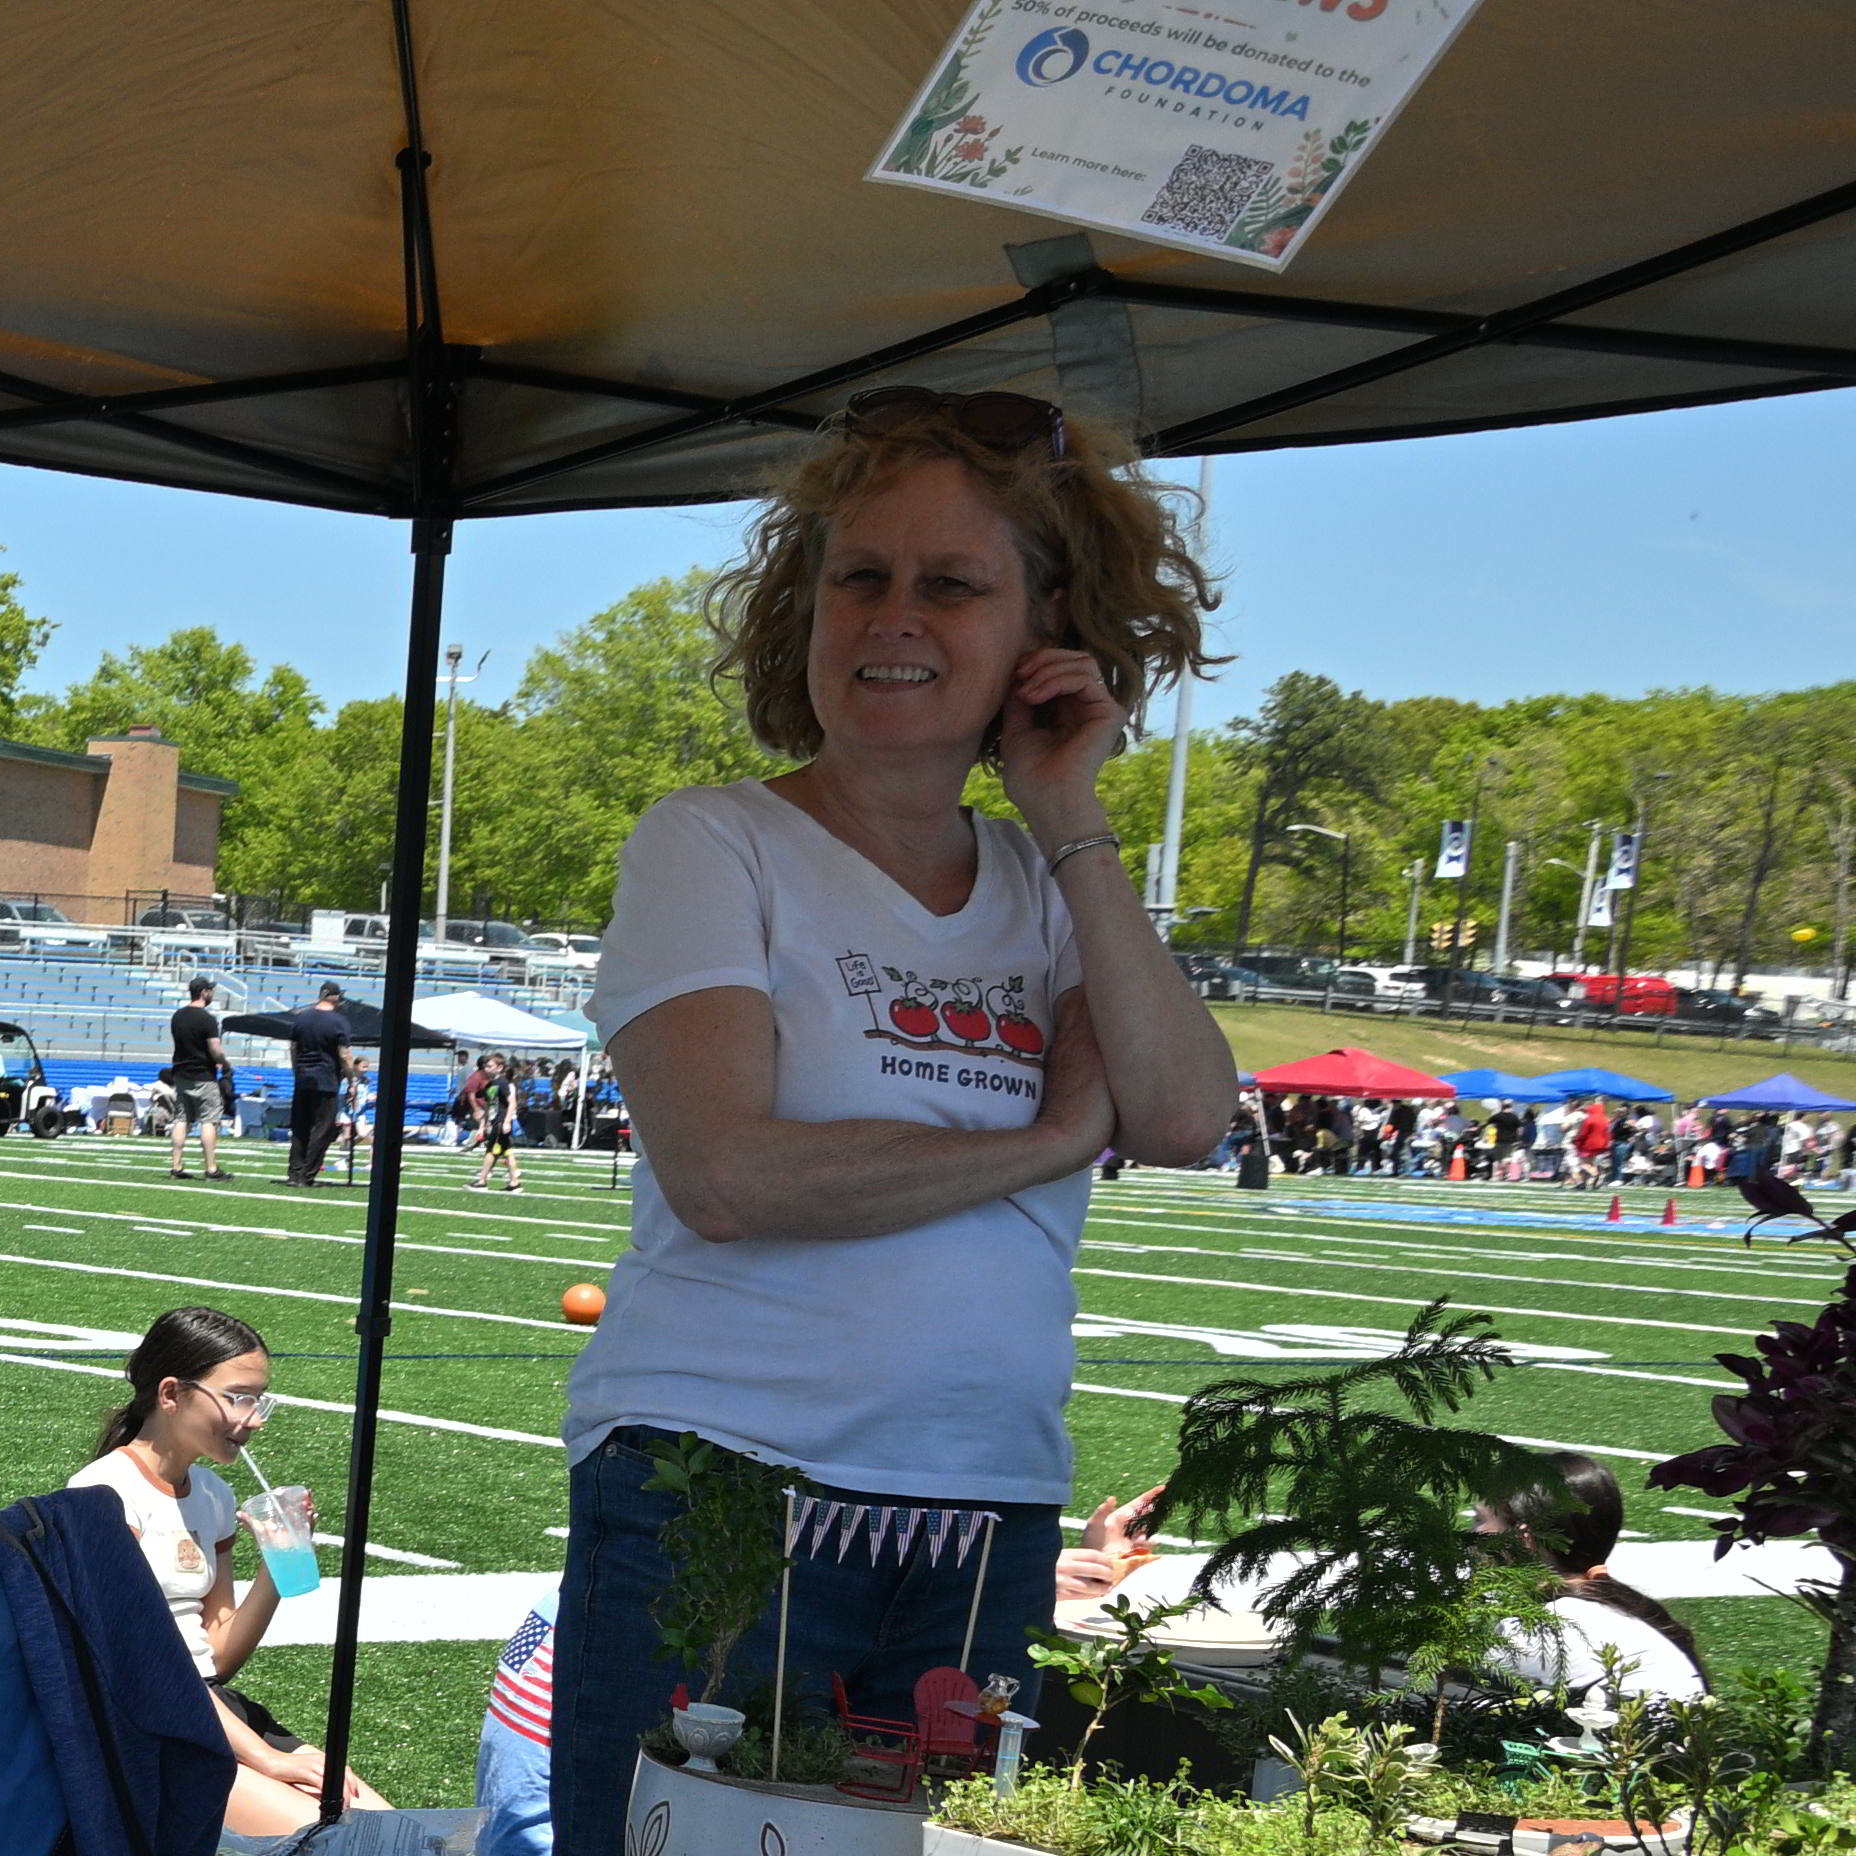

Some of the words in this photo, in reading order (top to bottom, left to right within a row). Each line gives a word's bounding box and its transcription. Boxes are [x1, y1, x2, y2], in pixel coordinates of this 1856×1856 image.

[1011, 0, 1050, 16] 50%
[1054, 5, 1078, 23] of
[1074, 8, 1163, 37] proceeds
[1167, 27, 1201, 46] will
[1205, 33, 1227, 52] be
[1231, 43, 1311, 74] donated
[1315, 62, 1334, 79] to
[1337, 67, 1372, 89] the
[1091, 49, 1311, 122] CHORDOMA
[1104, 86, 1266, 132] FOUNDATION
[1031, 147, 1070, 166] Learn
[1073, 156, 1111, 173] more
[1112, 160, 1148, 183] here:
[881, 1055, 950, 1084] HOME
[958, 1069, 1037, 1101] GROWN
